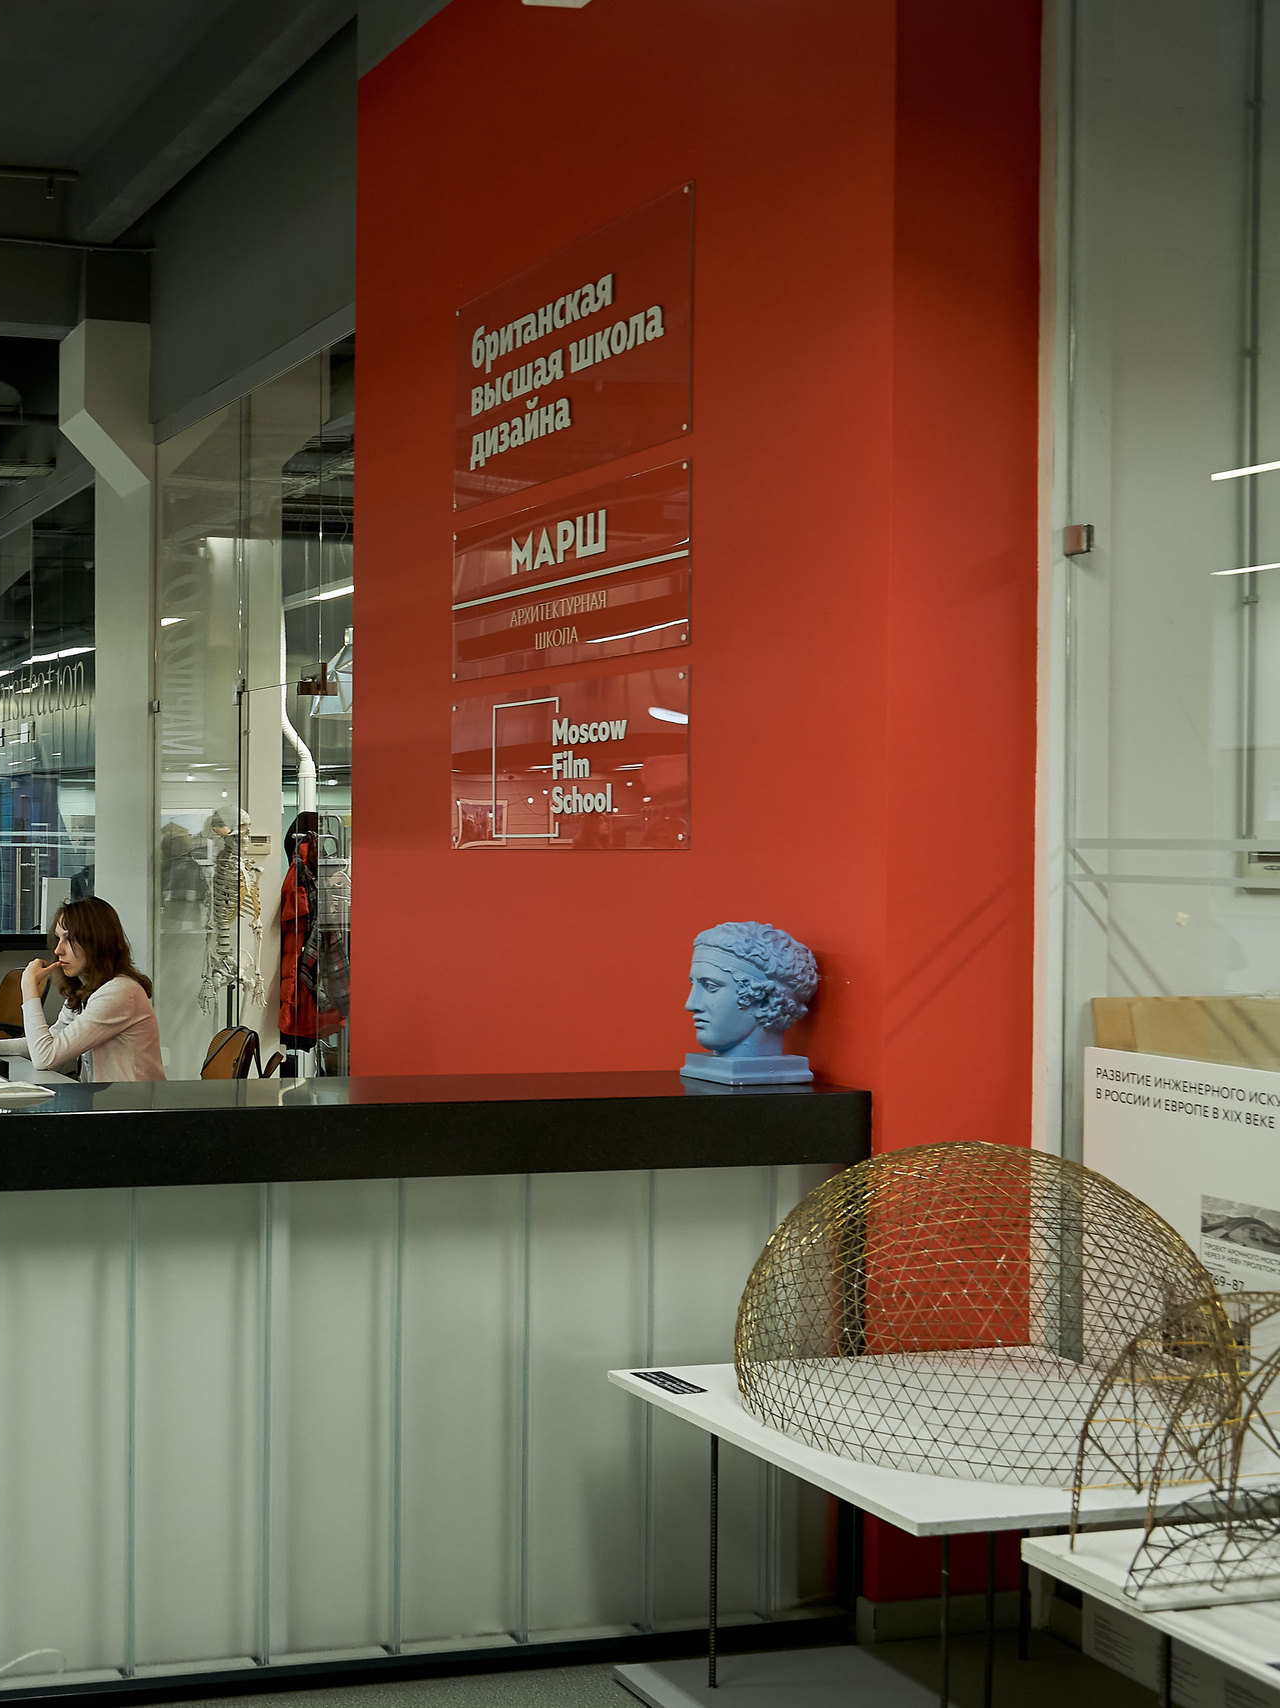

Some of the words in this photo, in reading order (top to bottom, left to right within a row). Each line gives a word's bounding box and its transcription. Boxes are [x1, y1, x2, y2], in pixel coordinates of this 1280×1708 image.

[472, 273, 613, 374] британская
[472, 349, 564, 417] высшая
[569, 305, 665, 373] школа
[470, 396, 571, 471] дизайна
[511, 509, 606, 575] МАРШ
[510, 590, 607, 627] АРХИТЕКТУРНАЯ
[535, 626, 578, 650] ШКОЛА
[552, 718, 627, 746] Moscow
[552, 750, 590, 780] Film
[552, 783, 612, 814] School
[1096, 1067, 1152, 1088] РАЗВИТИЕ
[1154, 1077, 1246, 1102] ИНЖЕНЕРНОГО
[1096, 1088, 1102, 1099] В
[1104, 1089, 1150, 1108] РОССИИ
[1153, 1098, 1162, 1109] И
[1164, 1099, 1209, 1118] ЕВРОПЕ
[1212, 1107, 1219, 1119] В
[1245, 1112, 1276, 1129] ВЕКЕ
